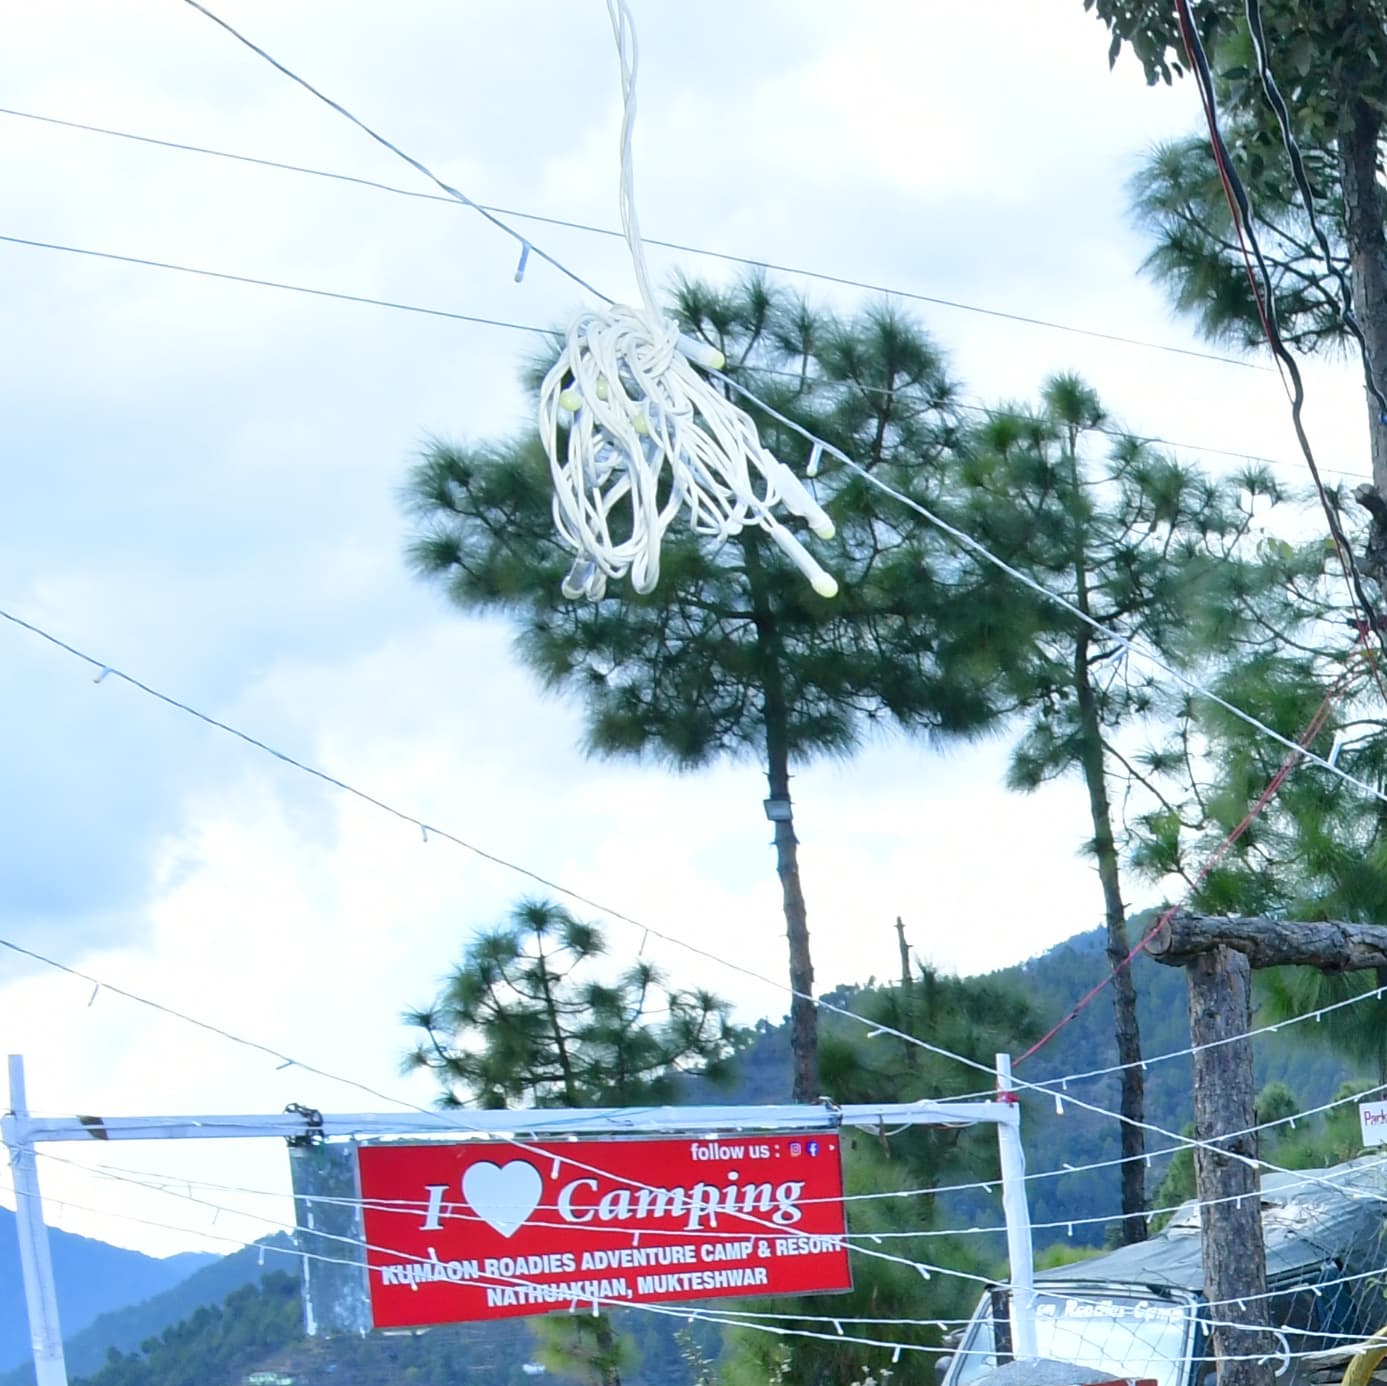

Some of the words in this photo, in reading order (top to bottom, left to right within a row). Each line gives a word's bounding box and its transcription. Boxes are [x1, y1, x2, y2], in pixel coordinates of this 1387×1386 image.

[690, 1142, 745, 1161] follow
[748, 1144, 771, 1159] us
[418, 1184, 450, 1231] I
[556, 1170, 805, 1231] Camping
[380, 1259, 479, 1286] KUMAON
[484, 1252, 577, 1278] ROADIES
[581, 1243, 697, 1271] ADVENTURE
[700, 1241, 753, 1263] CAMP
[757, 1239, 771, 1258] &
[775, 1235, 843, 1257] RESORT
[636, 1267, 768, 1295] MUKTESHWAR
